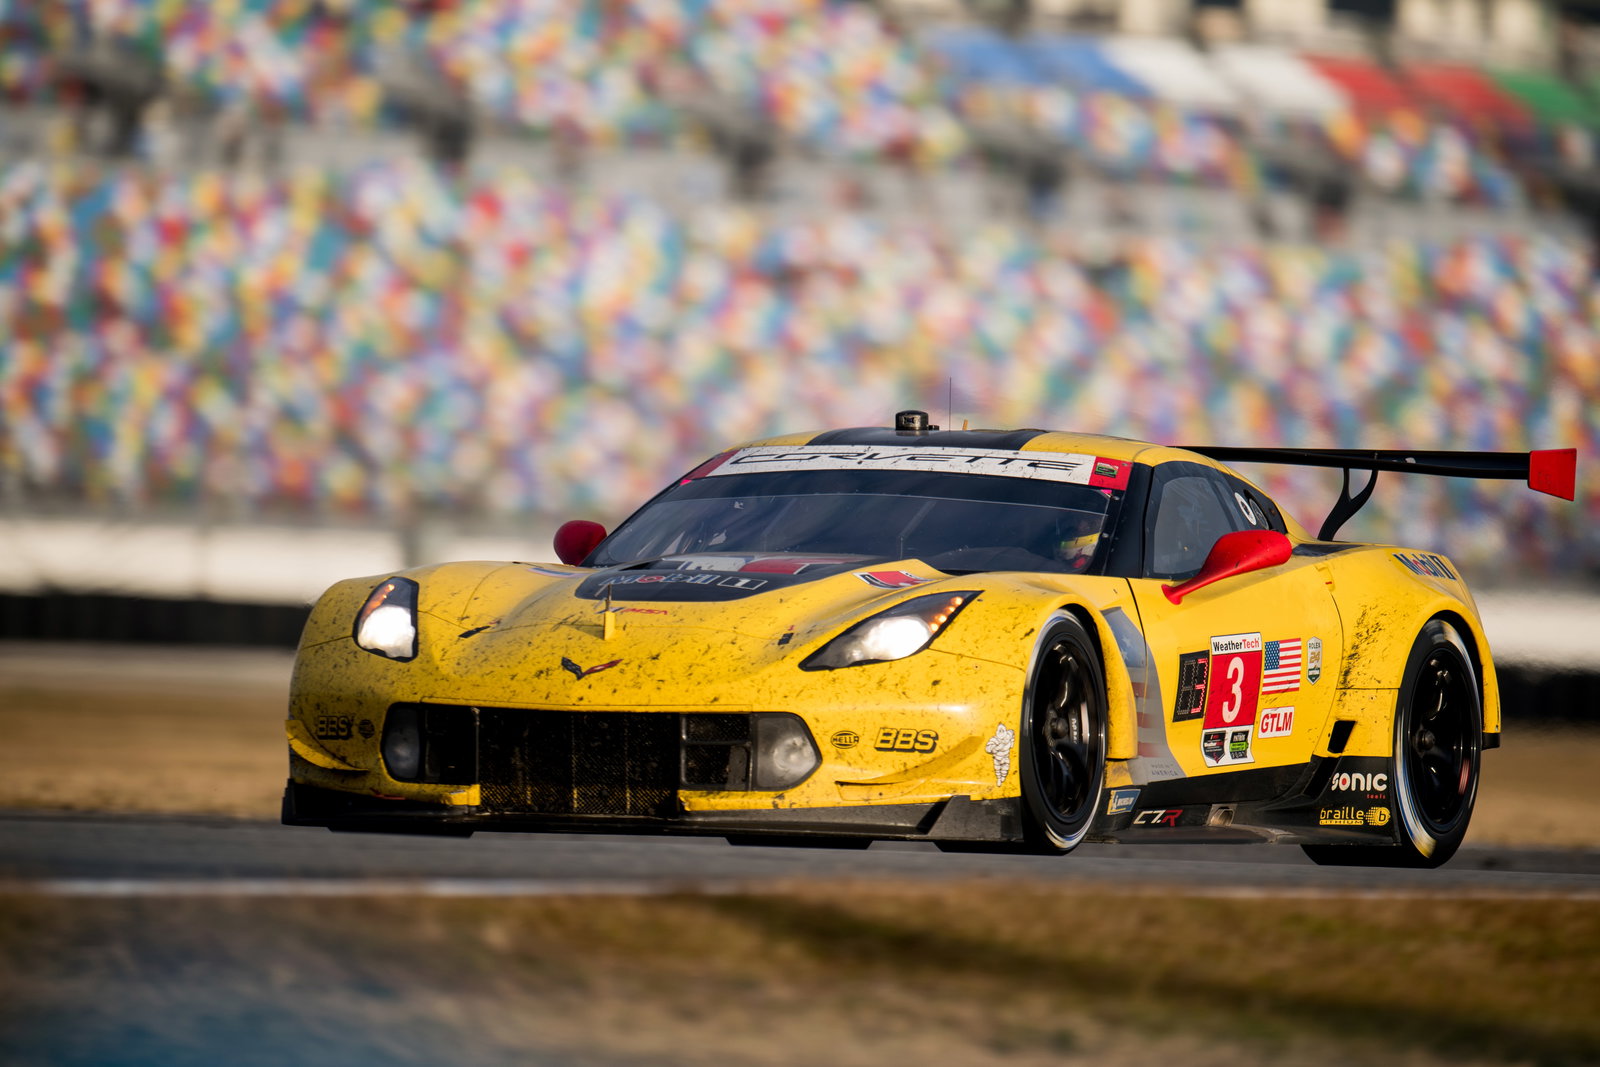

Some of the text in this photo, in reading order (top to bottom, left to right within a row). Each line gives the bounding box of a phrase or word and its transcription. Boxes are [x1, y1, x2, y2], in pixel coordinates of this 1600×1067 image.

[730, 451, 1082, 472] CORVETTE
[1392, 553, 1446, 578] Mobil
[599, 573, 721, 585] Mobil
[1213, 637, 1260, 652] WeatherTech
[1222, 656, 1245, 724] 3
[1260, 711, 1293, 734] GTLM
[832, 735, 860, 744] HELLA
[874, 727, 939, 754] BBS
[1319, 806, 1365, 820] braille
